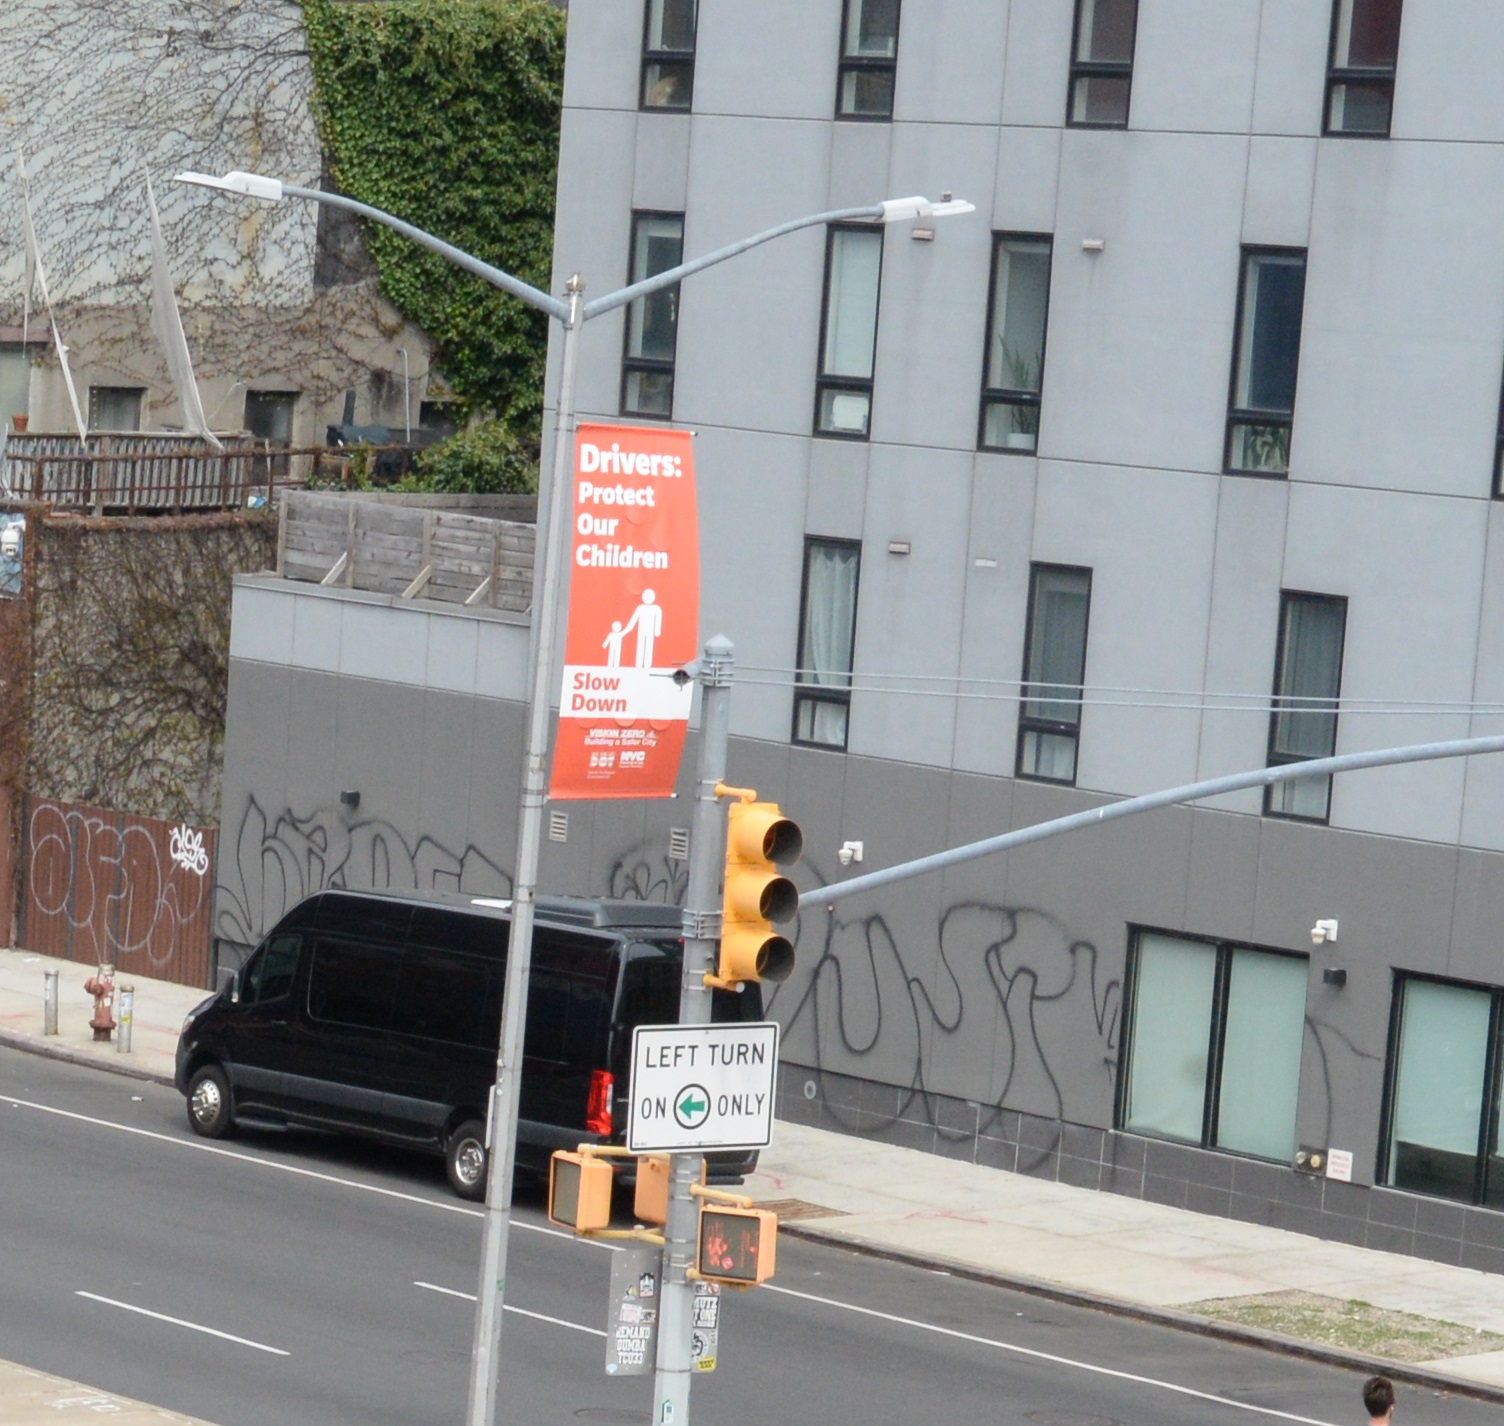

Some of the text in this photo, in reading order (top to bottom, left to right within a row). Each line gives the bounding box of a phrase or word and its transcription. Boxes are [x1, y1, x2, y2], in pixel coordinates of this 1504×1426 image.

[580, 443, 682, 478] Drivers:
[578, 482, 655, 506] Protect
[577, 512, 618, 536] Our
[576, 544, 668, 569] Children
[573, 672, 620, 690] Slow
[571, 694, 627, 712] Down
[590, 728, 646, 738] VISION ZERO
[620, 751, 646, 762] NYC
[646, 1042, 765, 1068] LEFT TURN
[641, 1093, 765, 1120] ON ONLY
